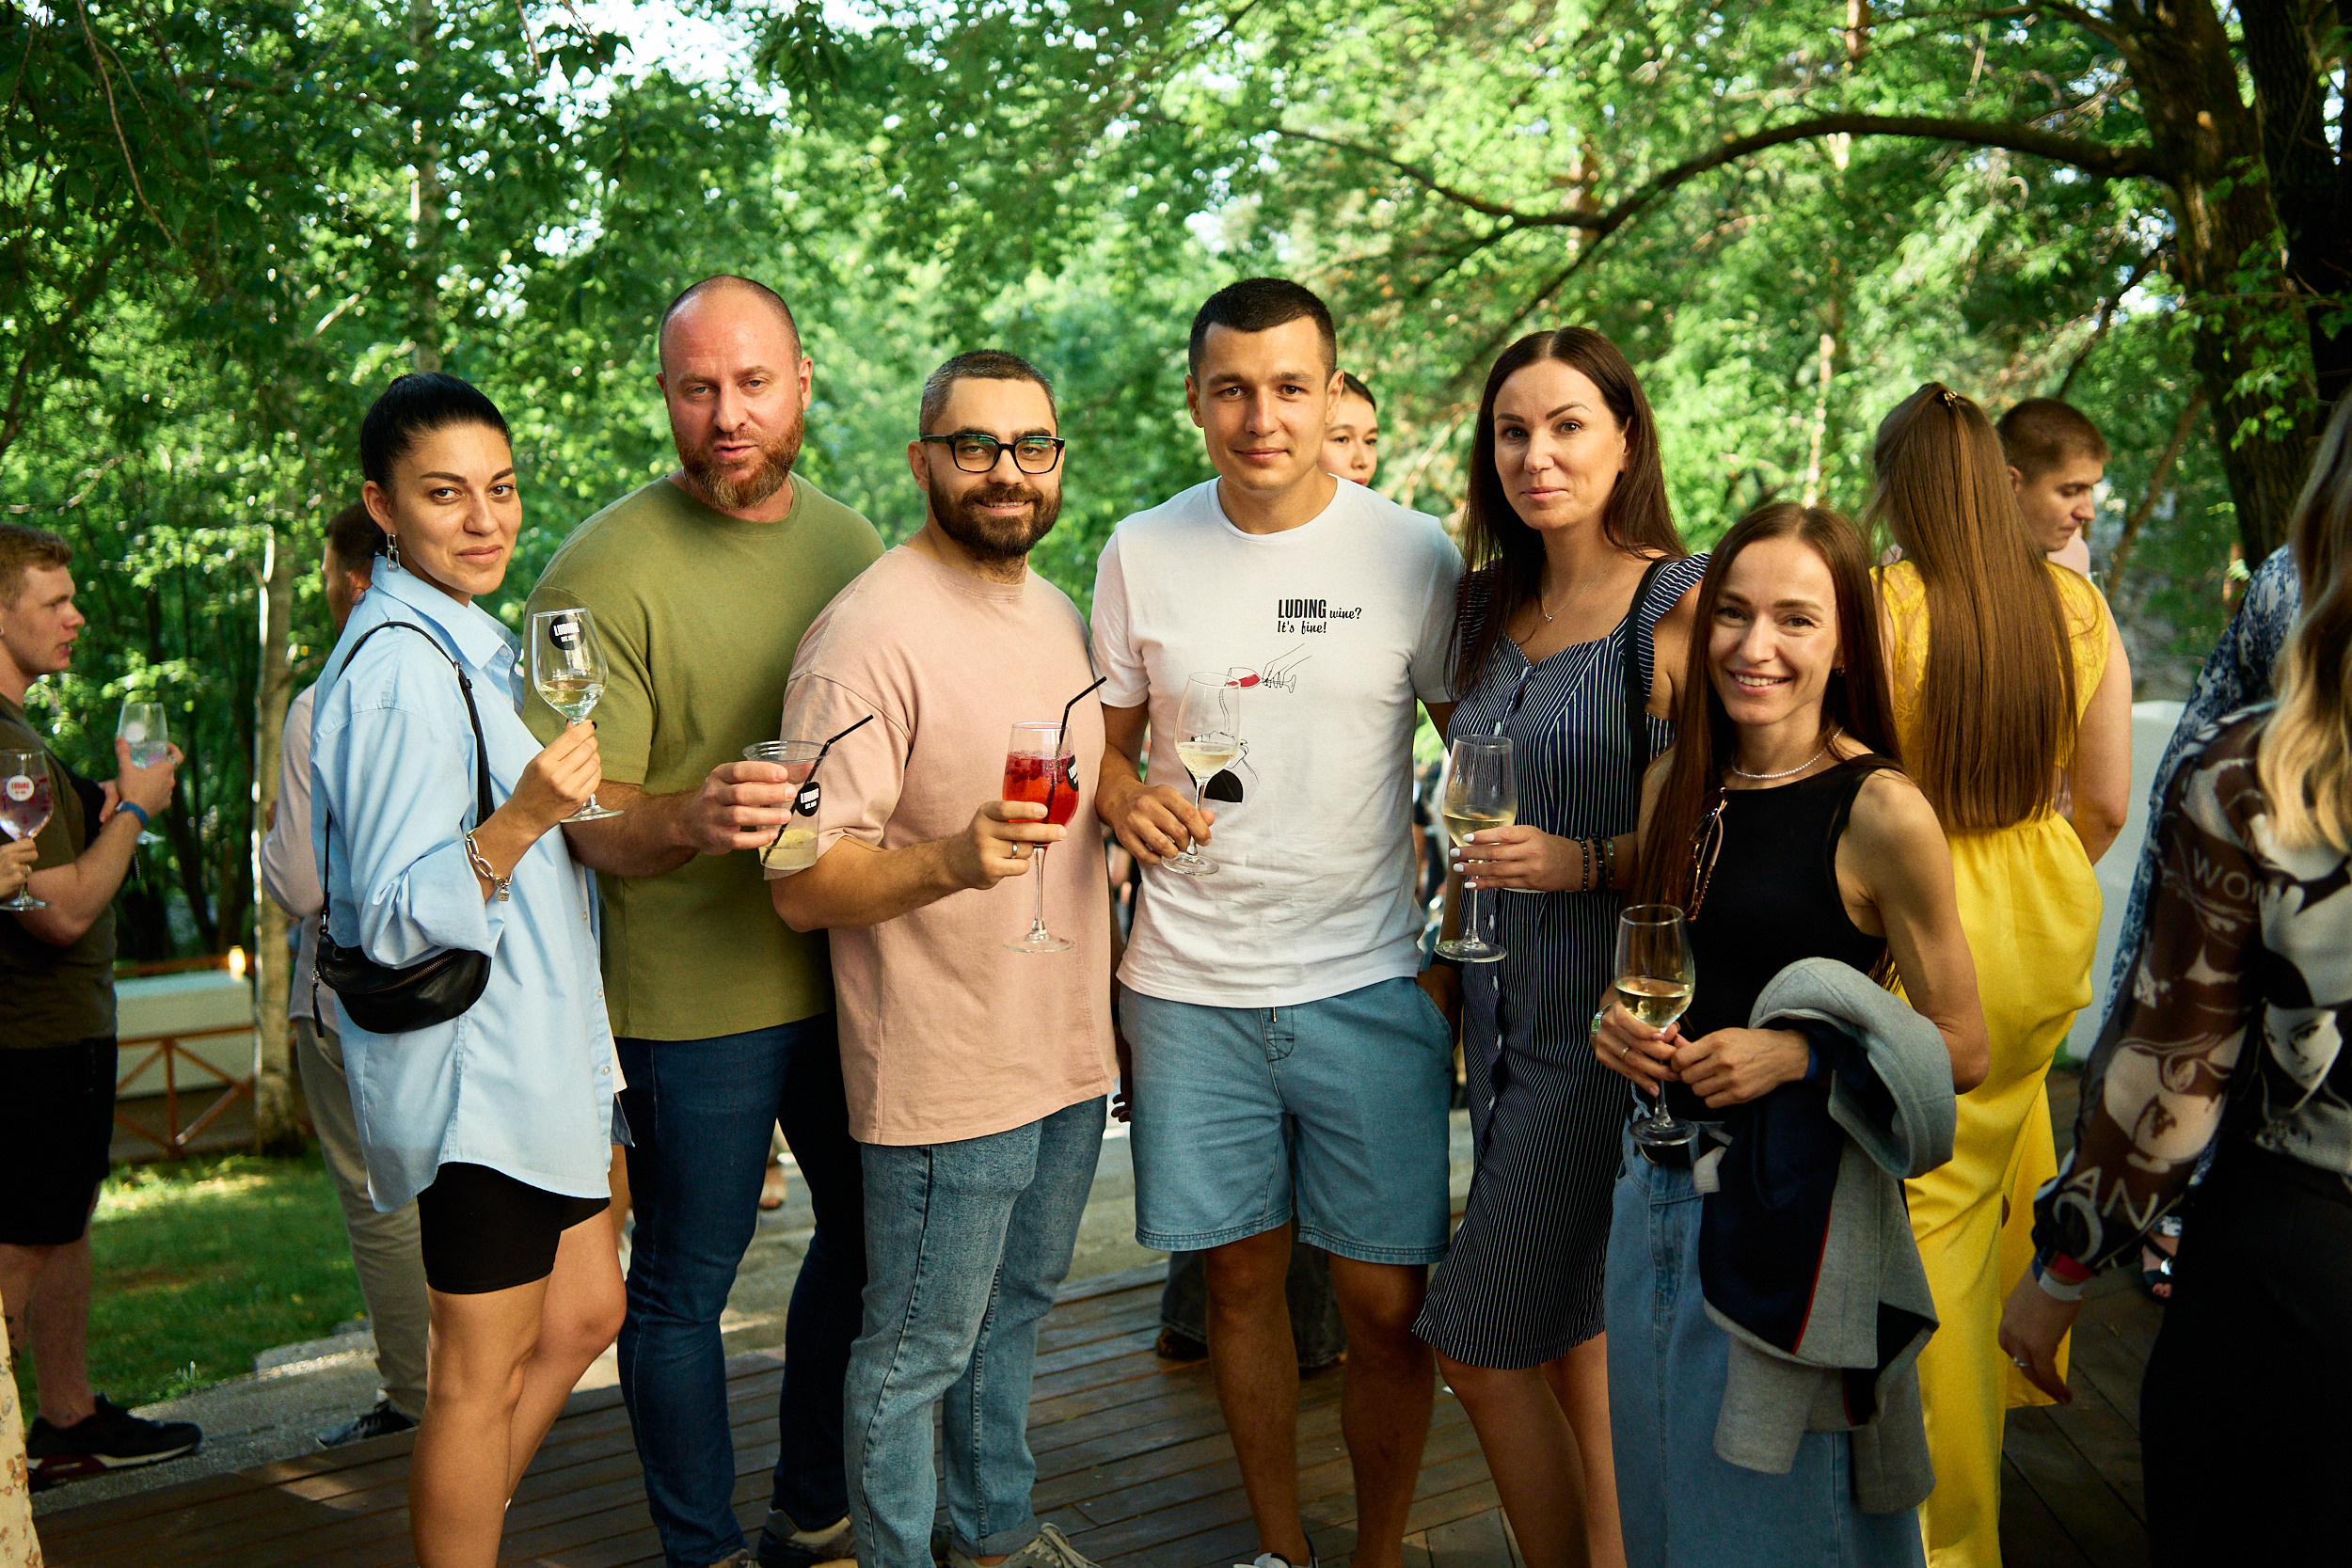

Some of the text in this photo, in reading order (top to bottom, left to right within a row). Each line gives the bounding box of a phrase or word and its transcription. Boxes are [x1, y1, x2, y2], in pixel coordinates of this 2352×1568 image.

[1278, 598, 1362, 620] LUDING wine?
[1277, 620, 1327, 635] It's fine!
